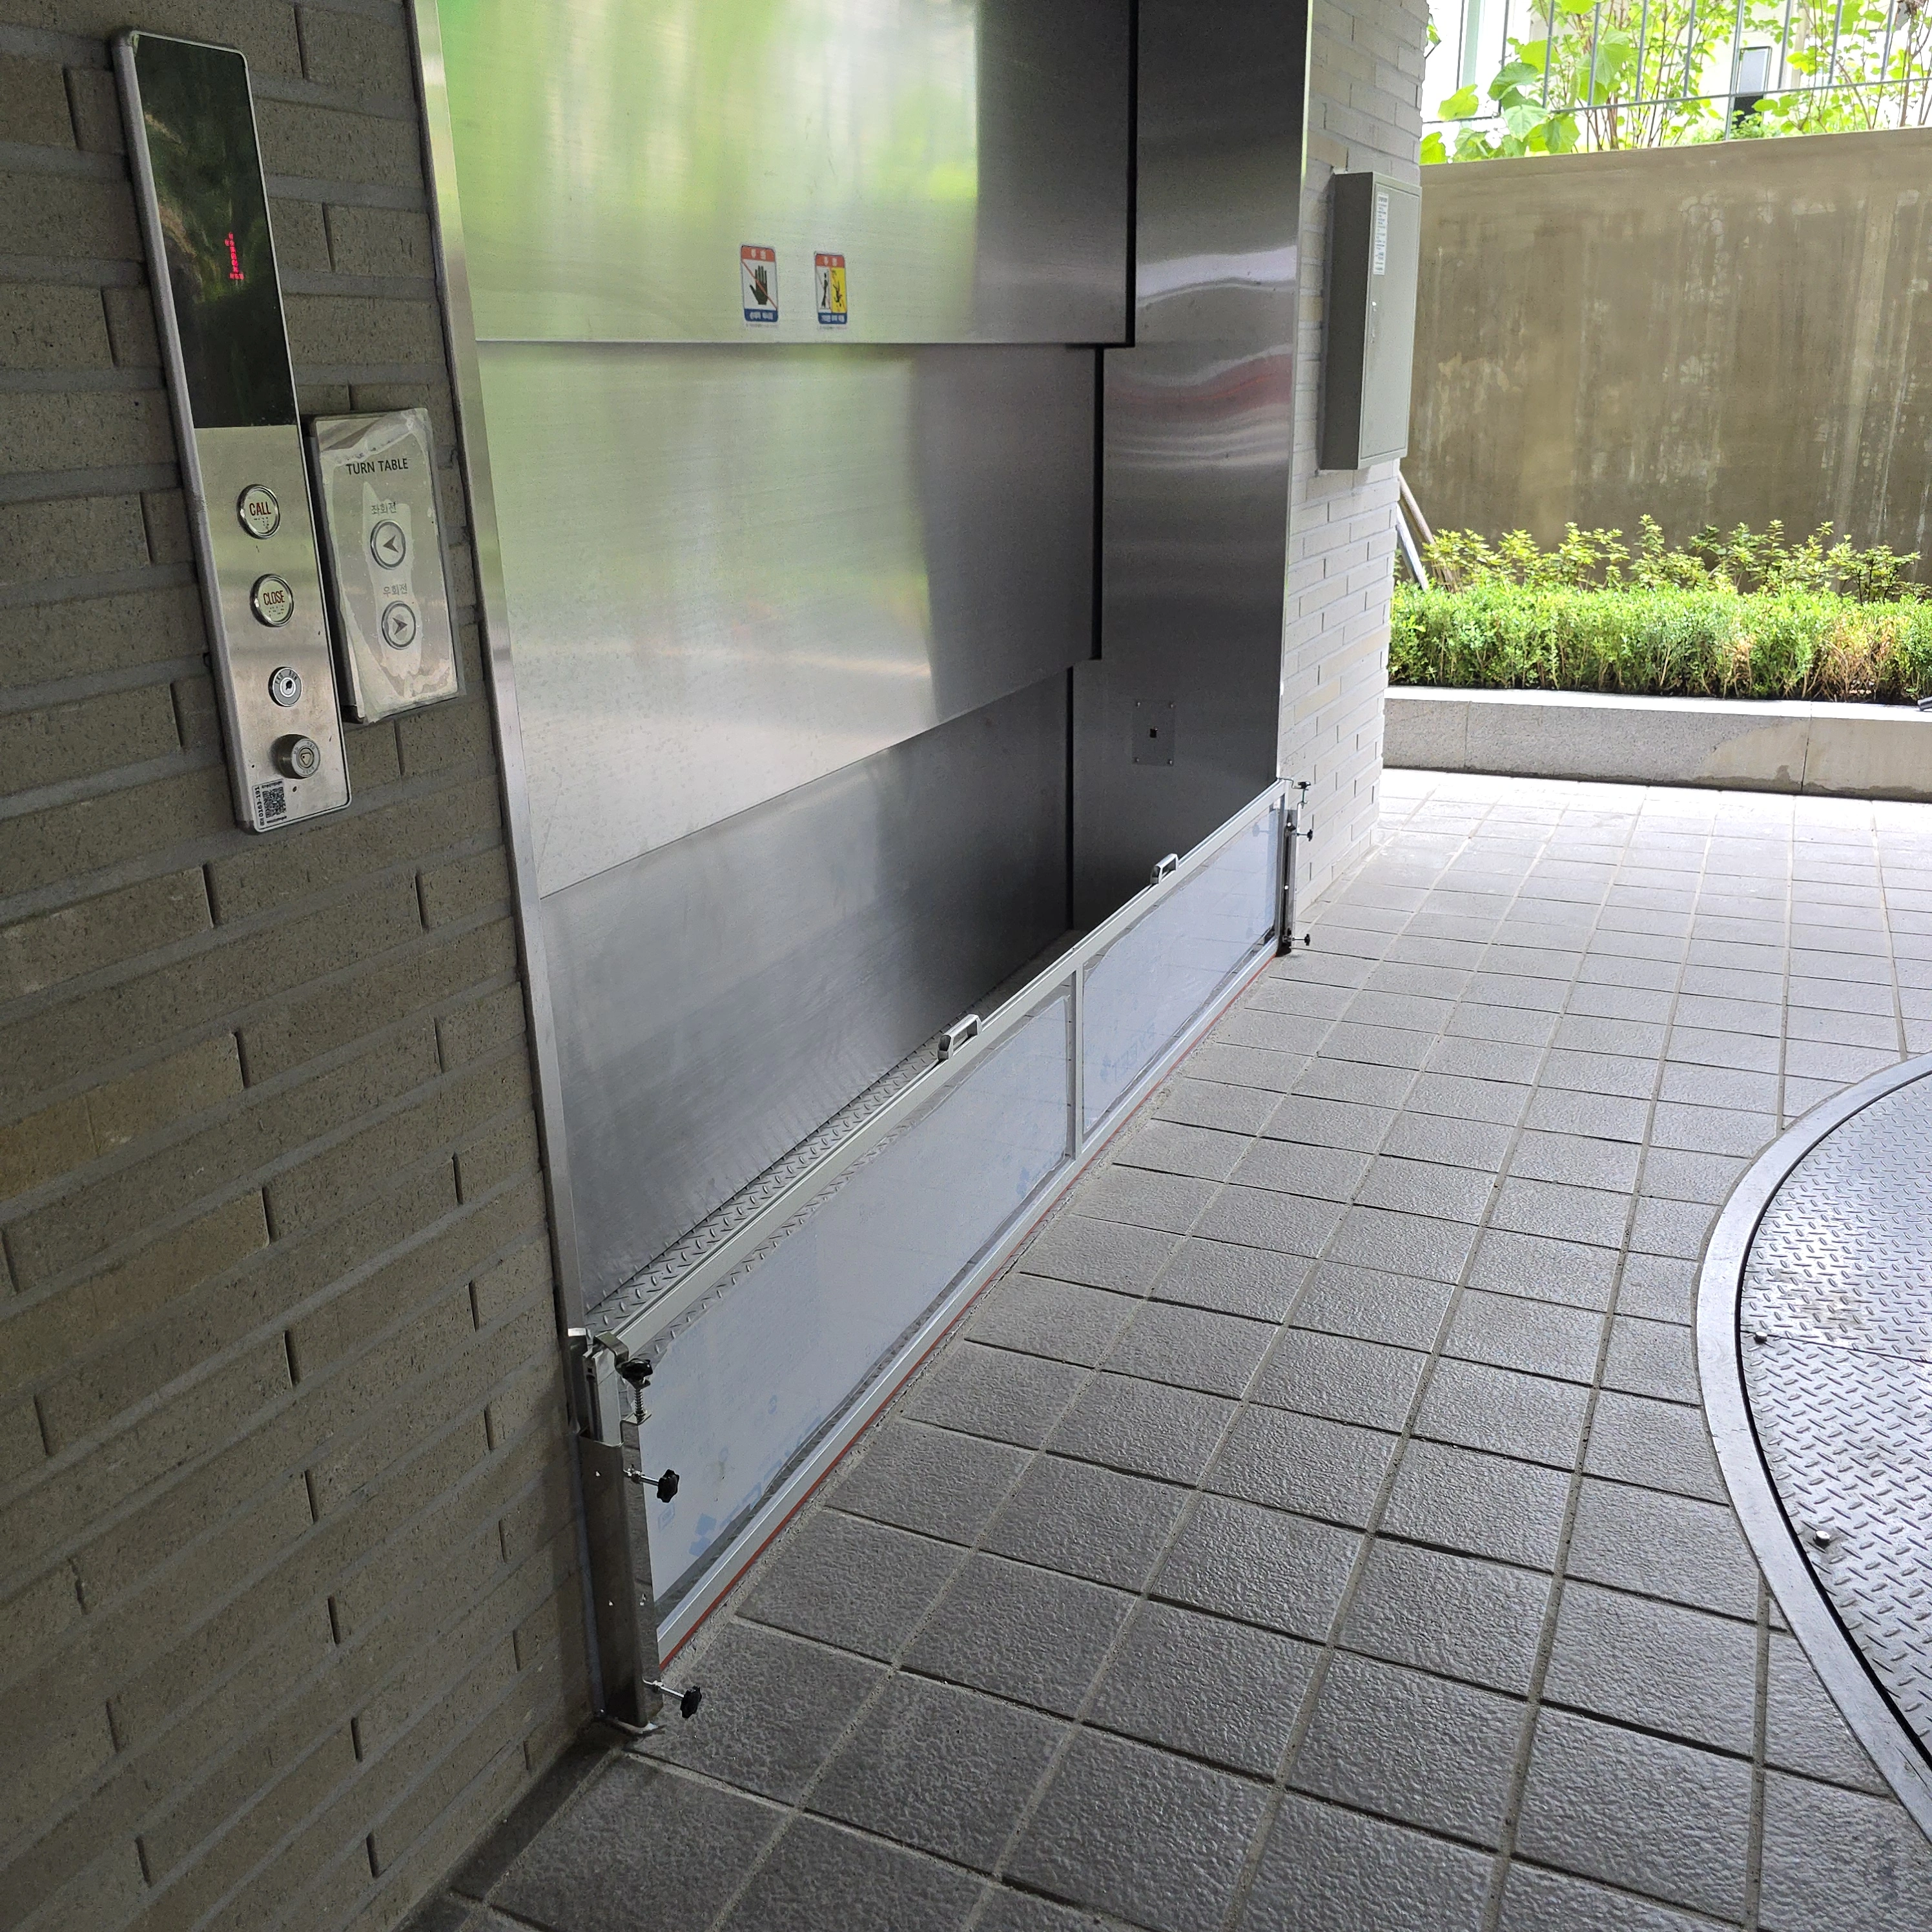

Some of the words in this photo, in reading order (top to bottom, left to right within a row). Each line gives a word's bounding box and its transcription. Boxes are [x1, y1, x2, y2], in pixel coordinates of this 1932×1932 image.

[345, 461, 375, 475] TURN
[378, 458, 409, 472] TABLE
[249, 501, 271, 516] CALL
[371, 501, 396, 515] 좌회전
[263, 590, 285, 606] CLOSE
[383, 582, 407, 598] 우회전
